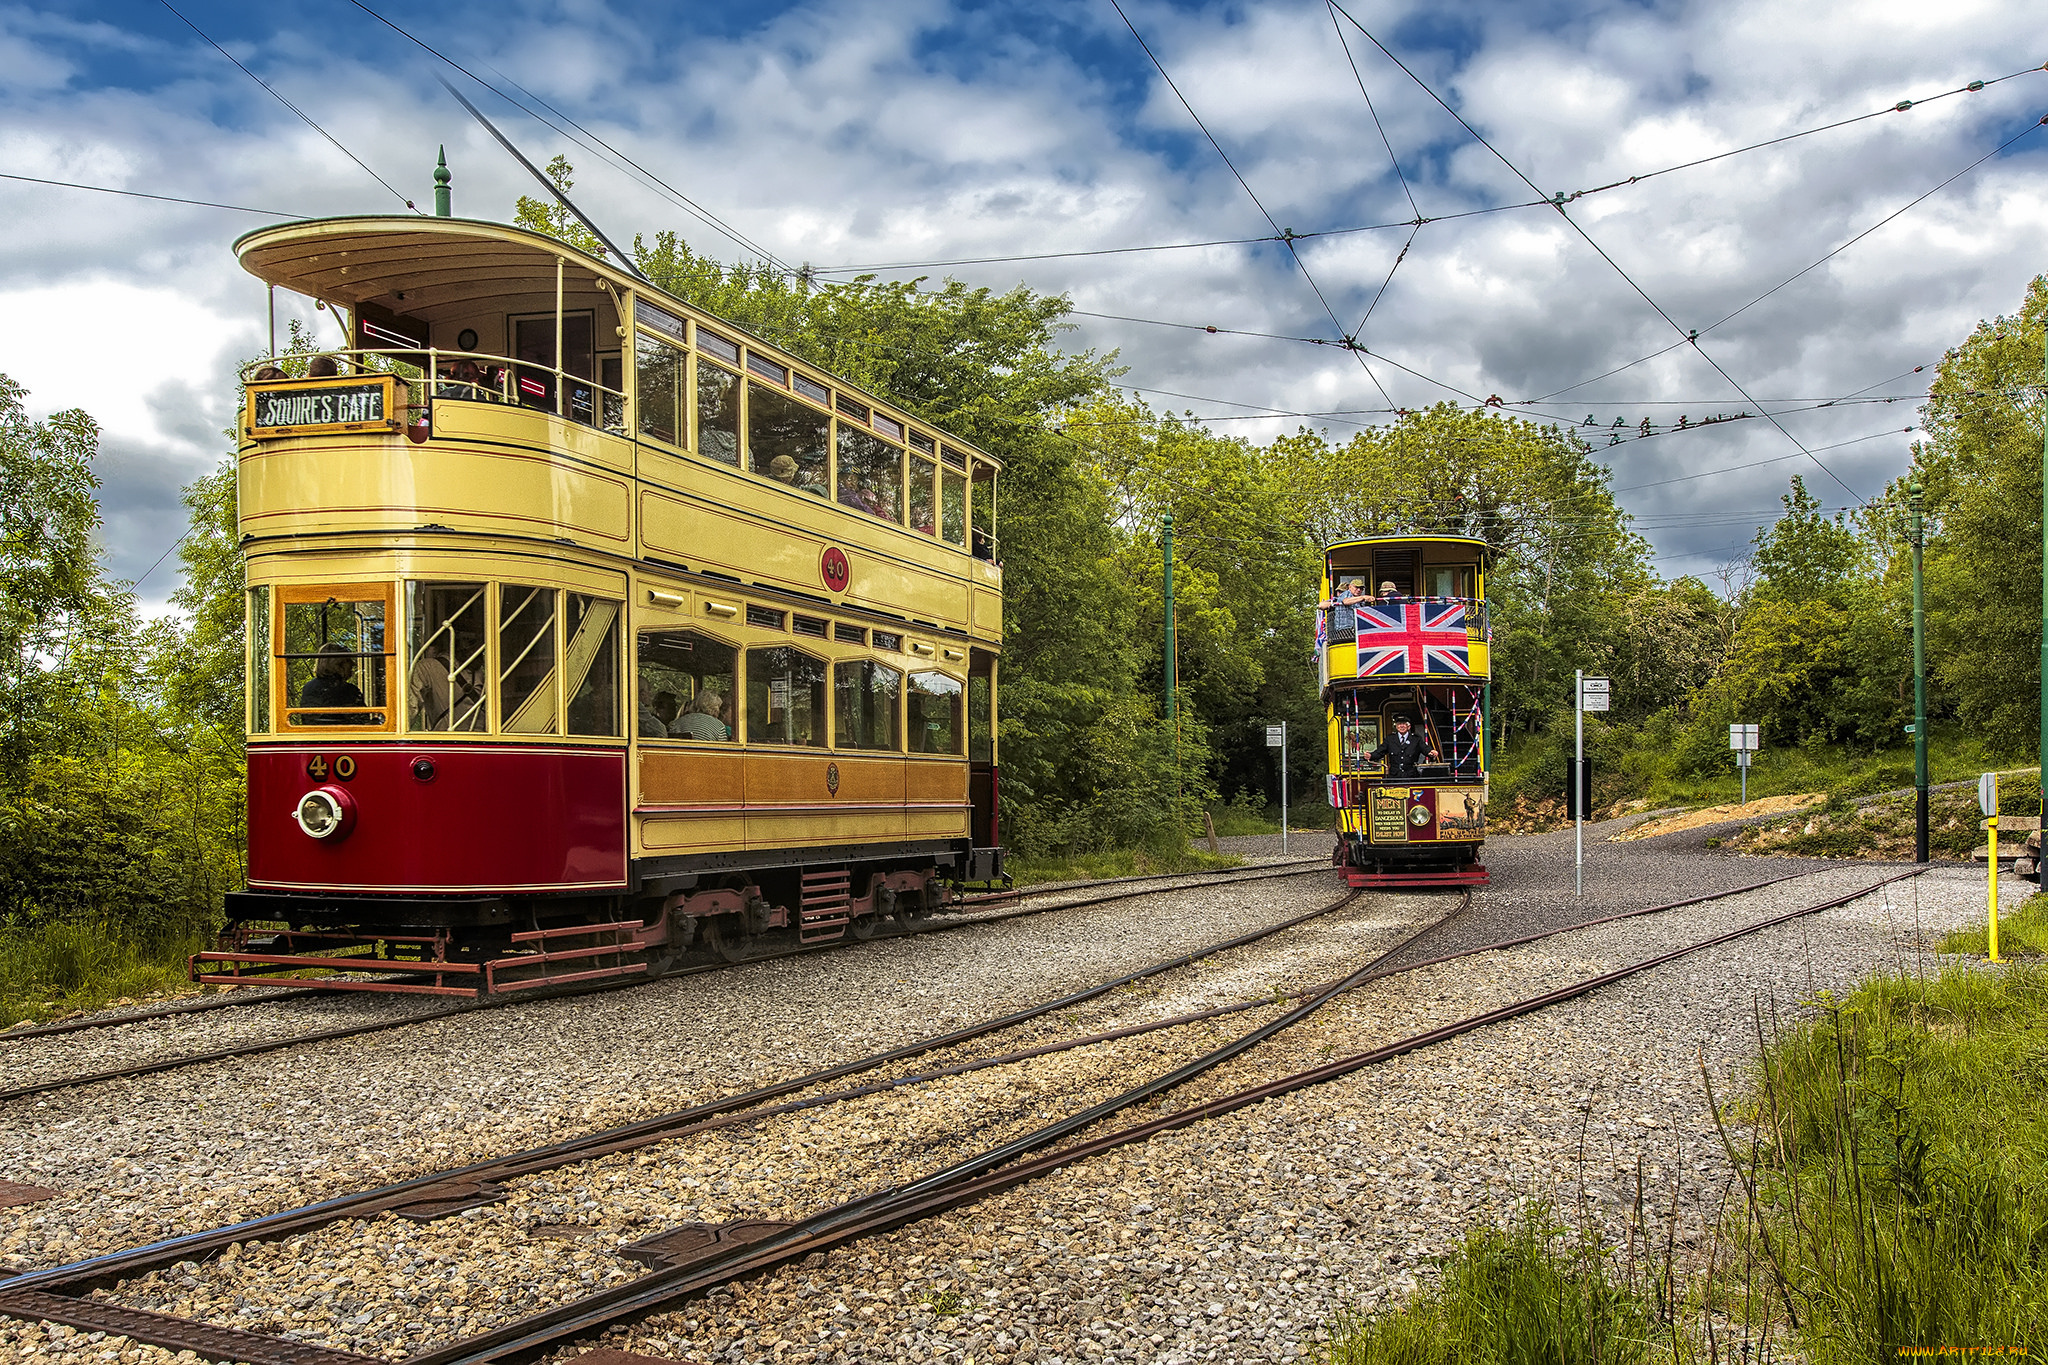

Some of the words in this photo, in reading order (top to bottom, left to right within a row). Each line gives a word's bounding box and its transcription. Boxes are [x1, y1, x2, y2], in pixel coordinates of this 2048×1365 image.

[265, 395, 332, 426] SQUIRES
[337, 392, 381, 422] GATE
[827, 558, 844, 577] 40
[308, 755, 355, 777] 40
[1376, 798, 1401, 809] MEN
